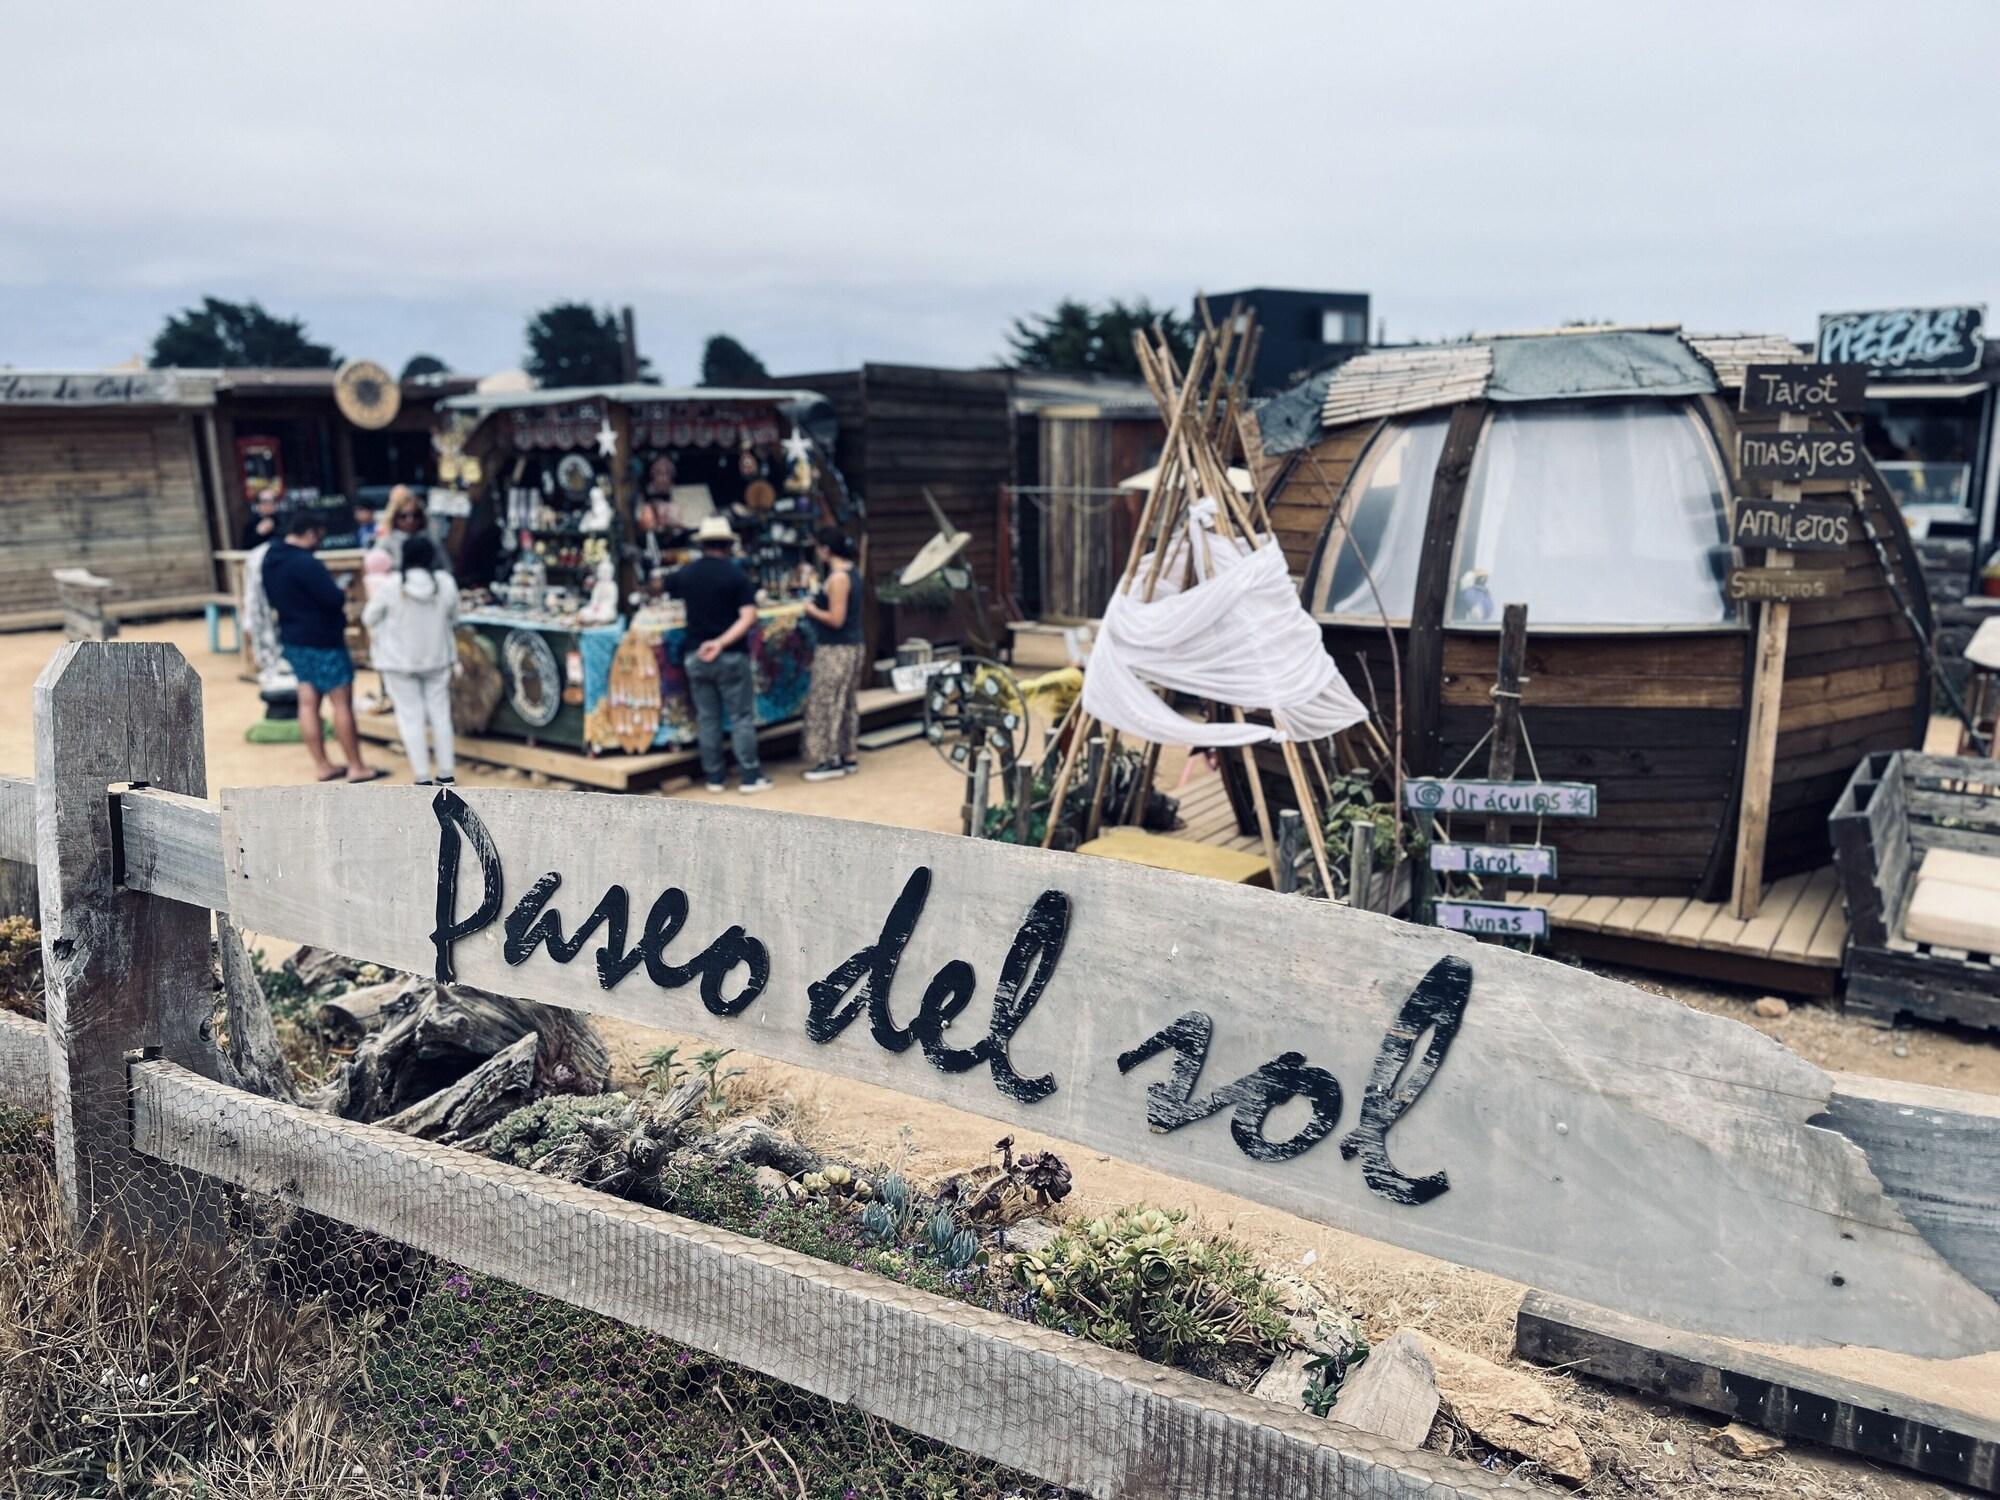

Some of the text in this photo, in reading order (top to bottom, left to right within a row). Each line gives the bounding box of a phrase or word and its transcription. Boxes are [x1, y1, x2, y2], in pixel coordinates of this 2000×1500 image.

[1759, 374, 1838, 404] Tarot
[1463, 849, 1521, 874] Tarot
[1463, 909, 1522, 931] Runas
[429, 787, 1473, 1206] Paseo del sol
